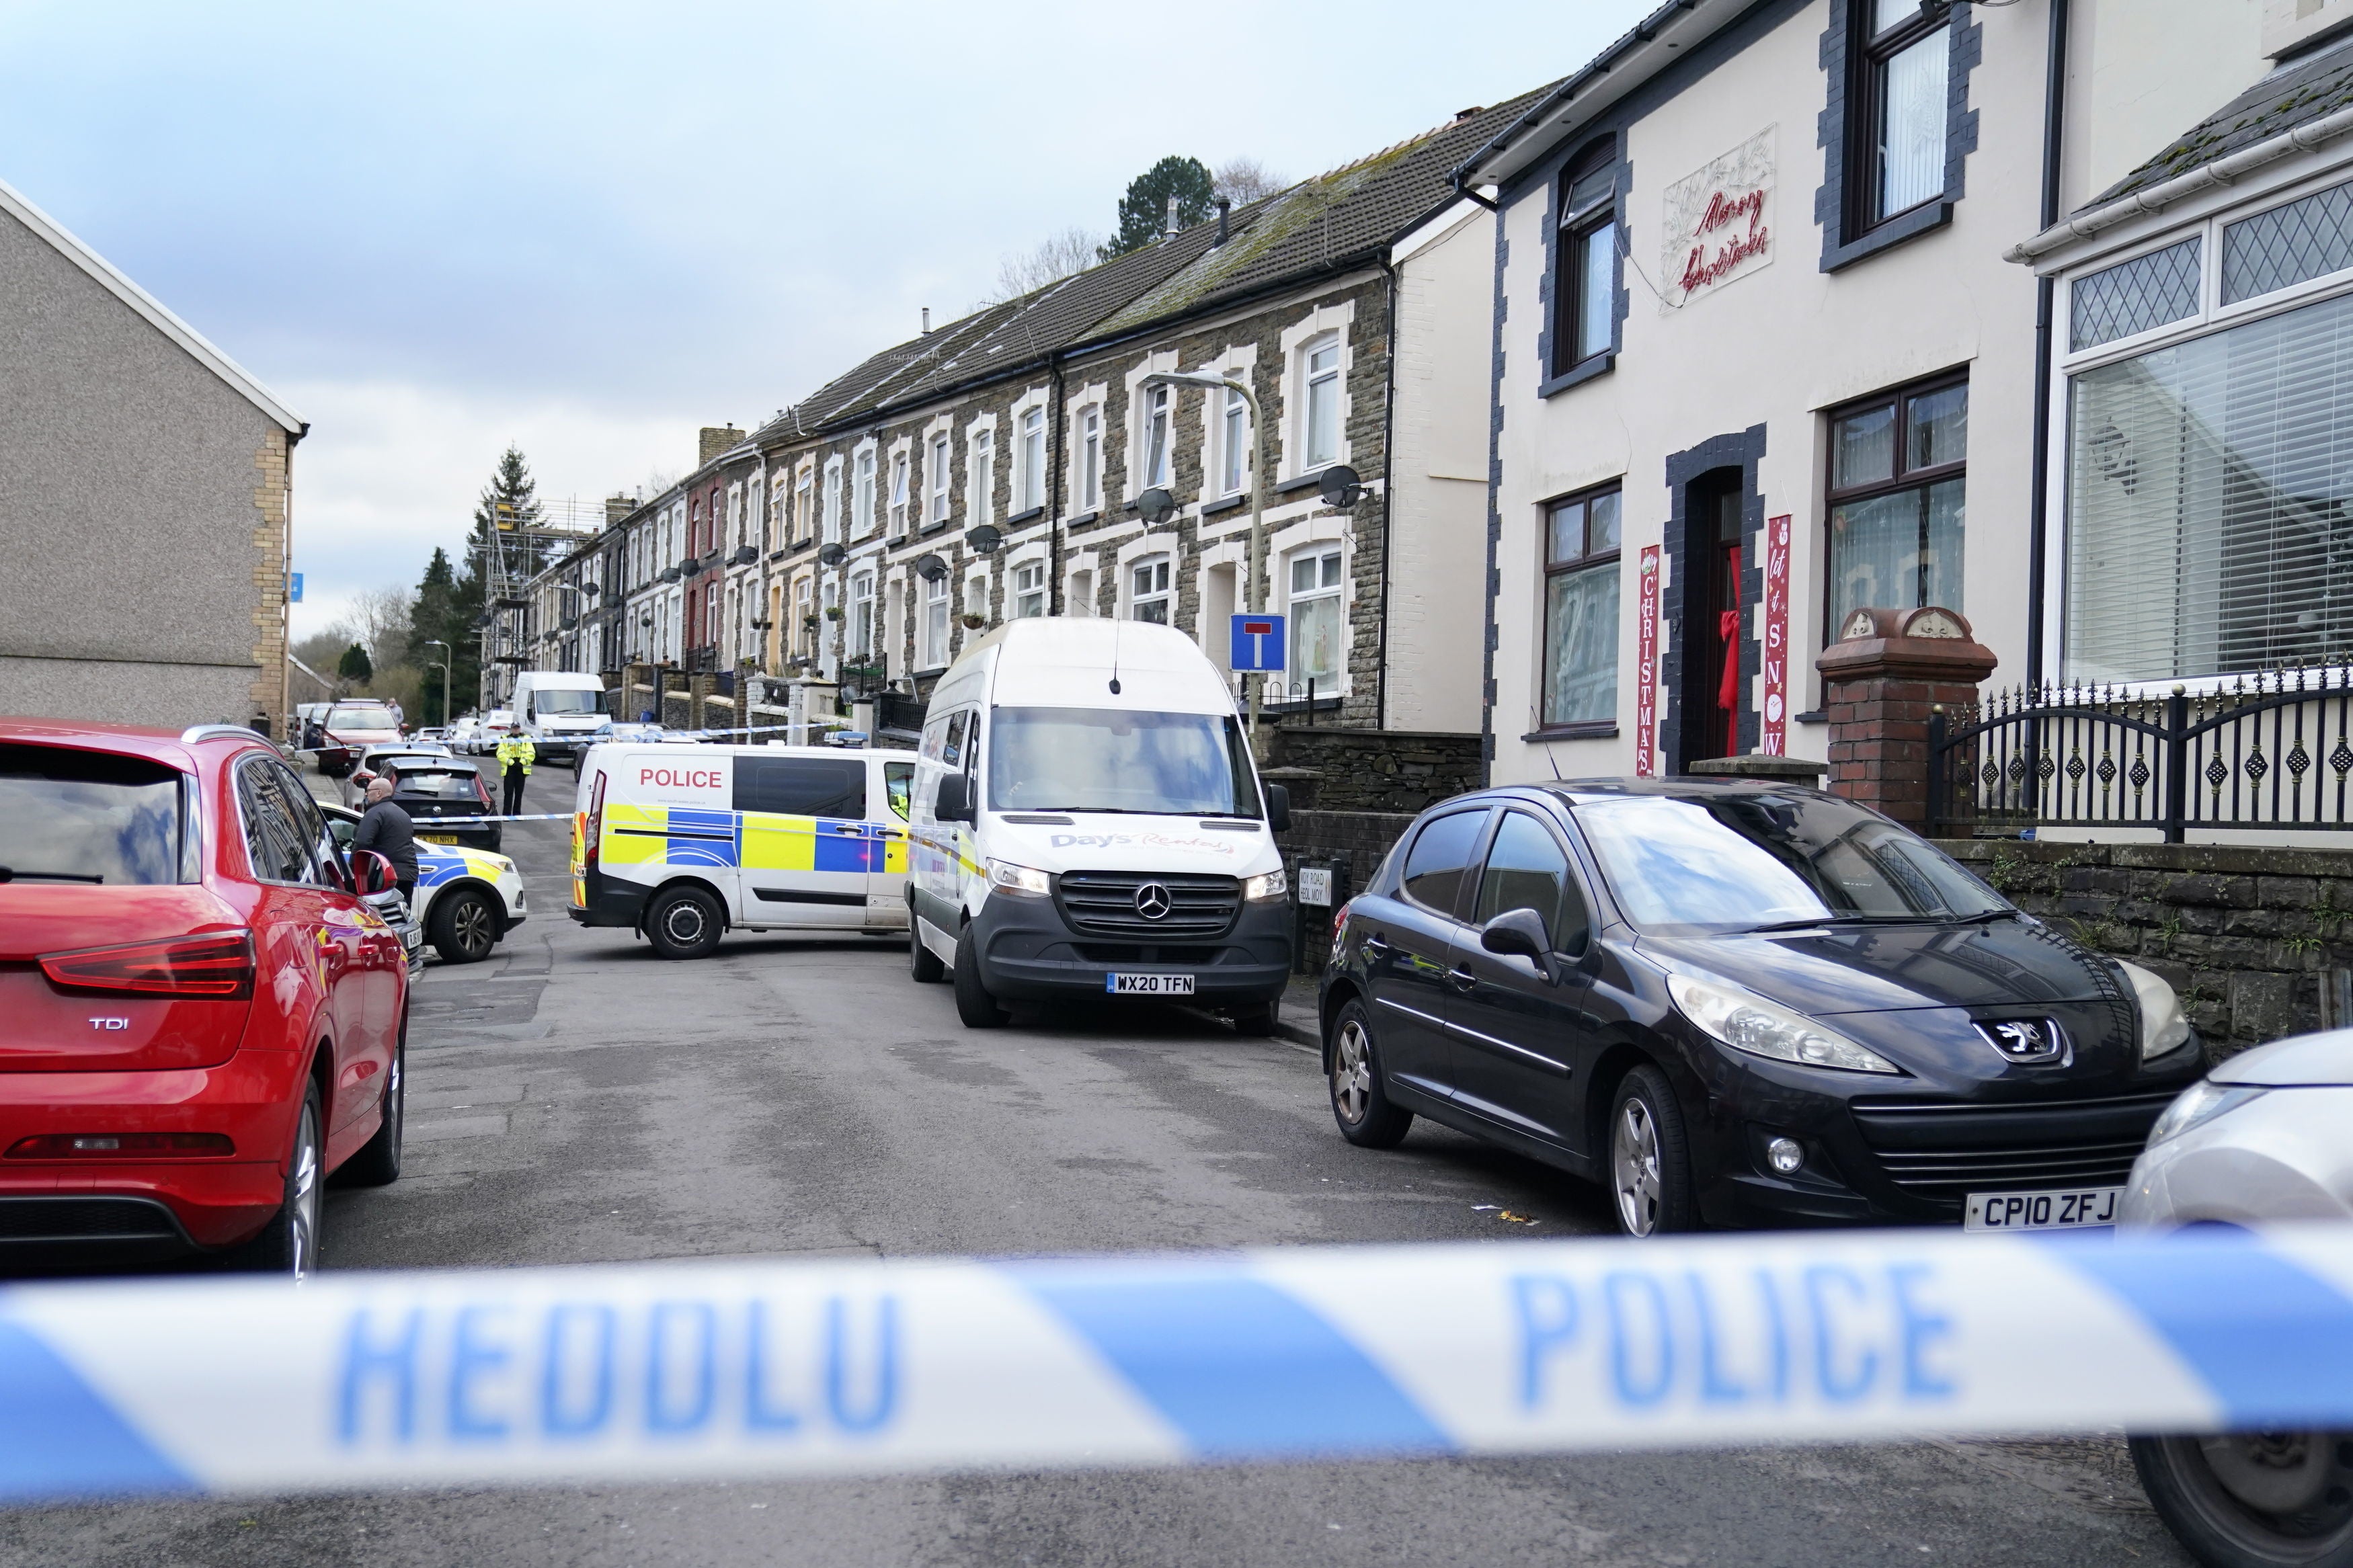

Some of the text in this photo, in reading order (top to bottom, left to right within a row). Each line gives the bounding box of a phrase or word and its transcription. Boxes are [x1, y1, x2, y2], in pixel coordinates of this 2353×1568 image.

[1769, 549, 1785, 579] let
[1639, 576, 1654, 771] CHRISTMAS
[641, 769, 721, 788] POLICE
[440, 836, 454, 844] NHX
[1300, 871, 1324, 886] MOY ROAD
[1300, 887, 1323, 902] HEOL MOY
[1118, 976, 1158, 991] WX20
[1163, 977, 1193, 991] TFN
[89, 1018, 128, 1030] TDI
[1985, 1192, 2116, 1227] CP10 ZFJ
[333, 1264, 1958, 1445] HEDDLU POLICE
